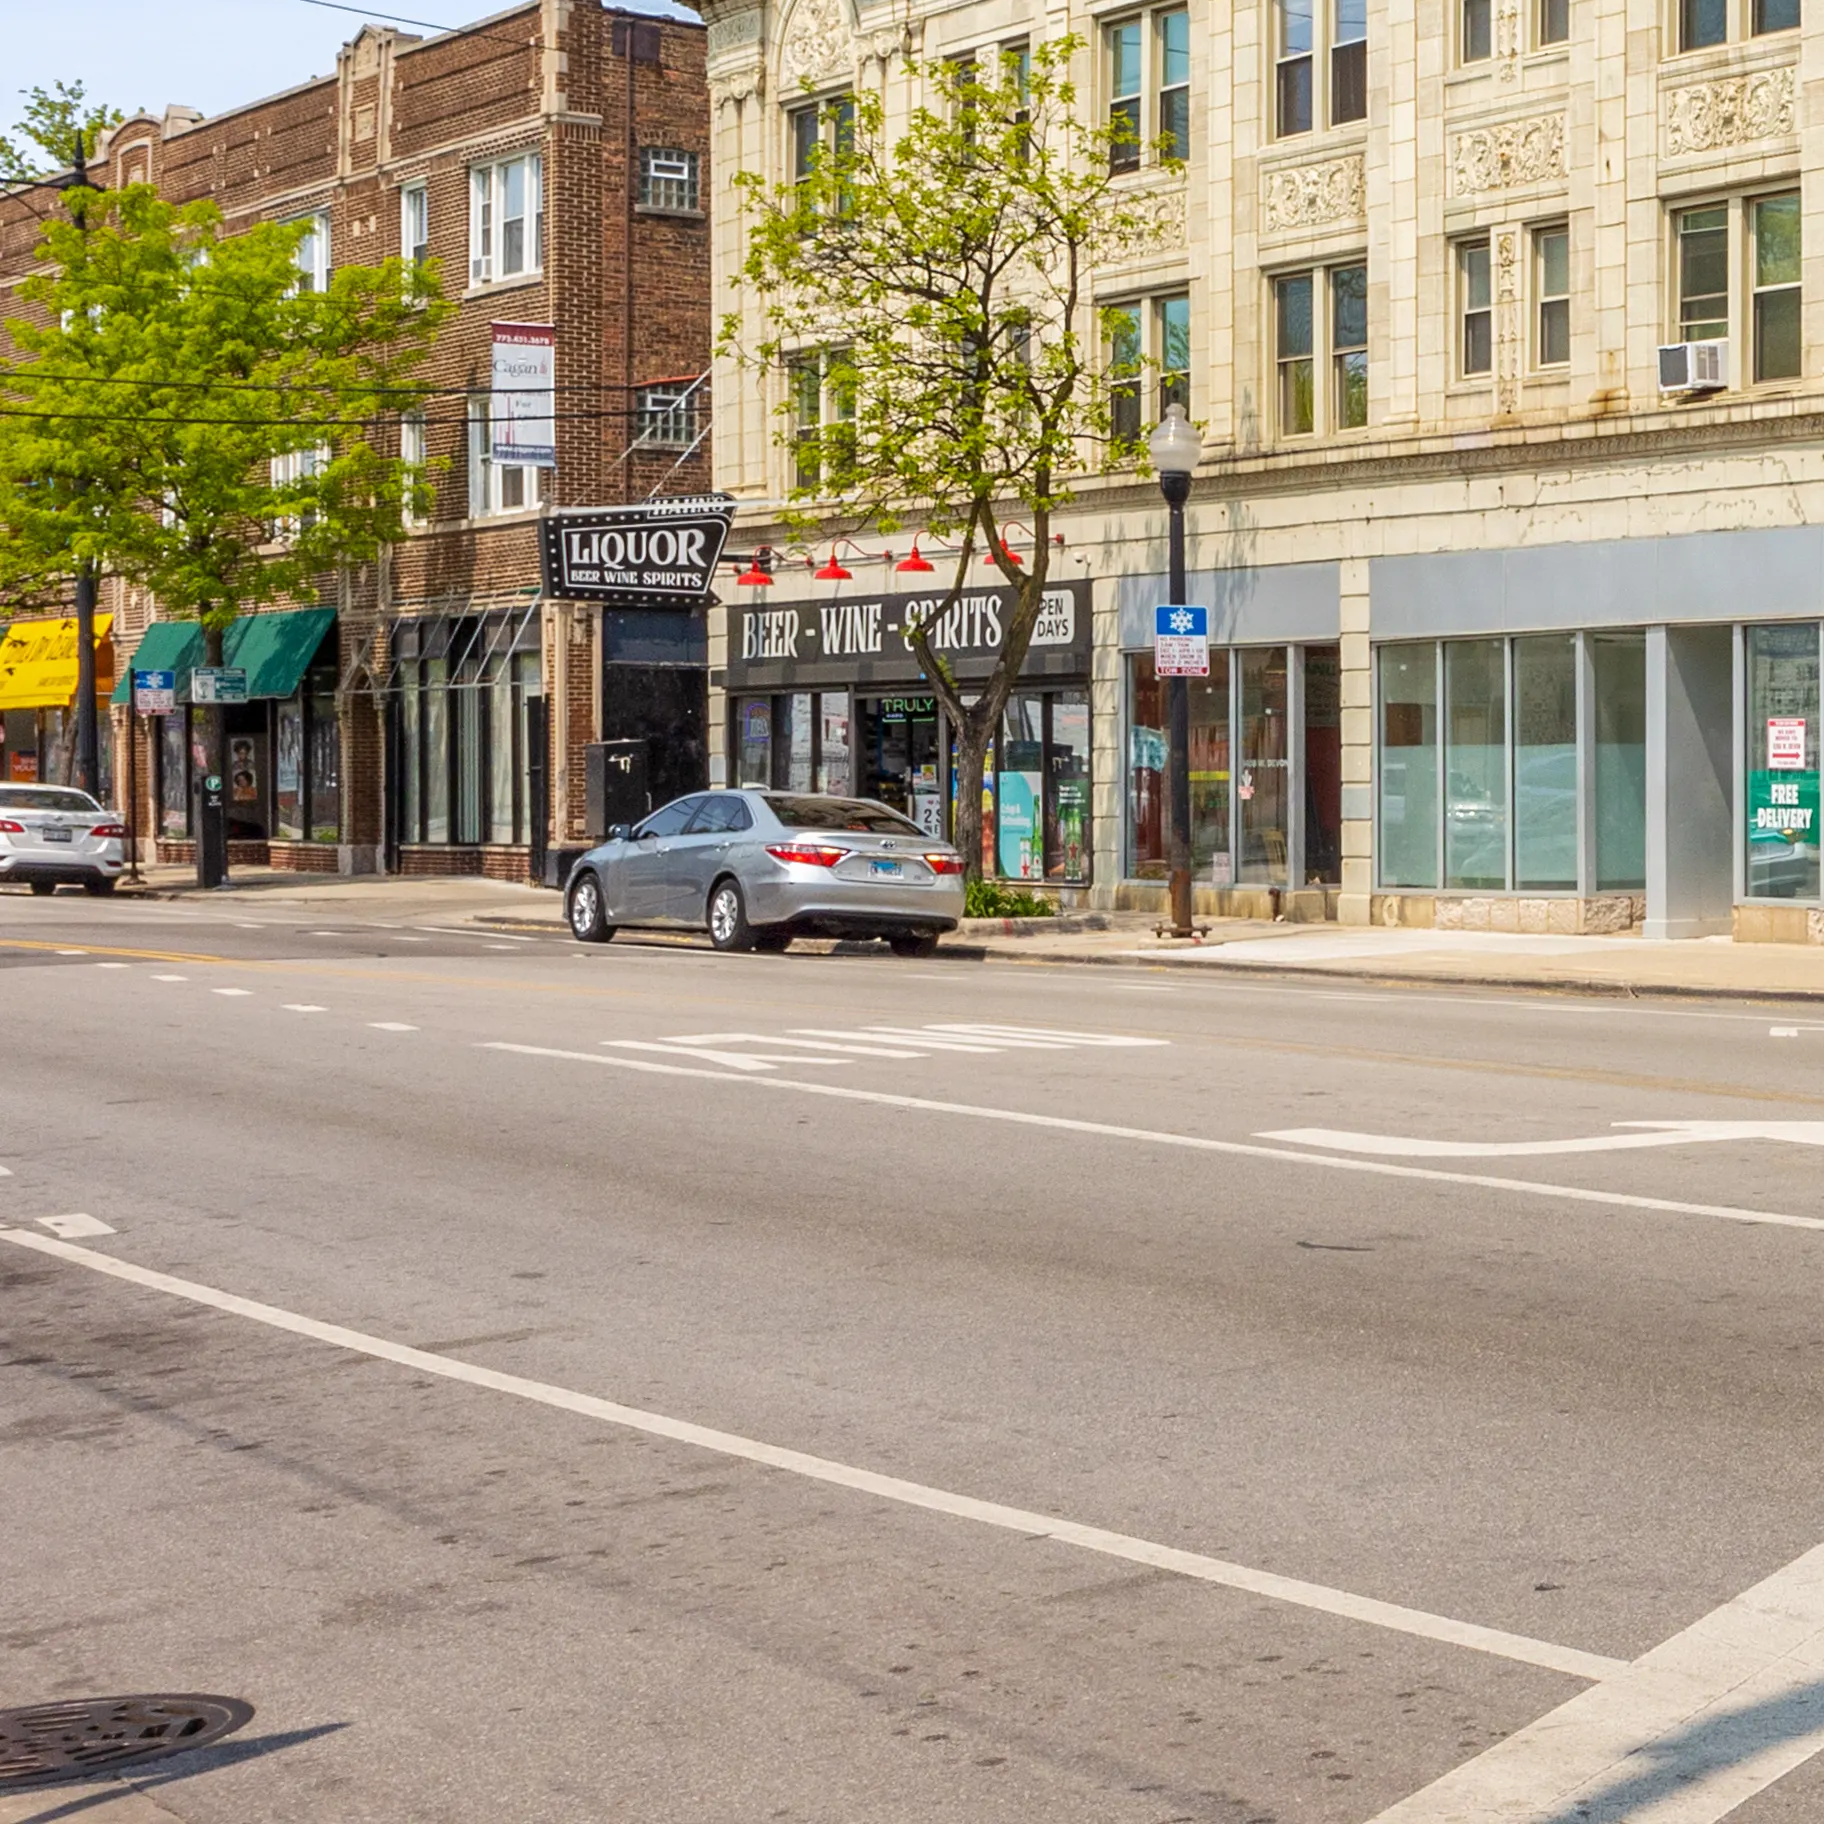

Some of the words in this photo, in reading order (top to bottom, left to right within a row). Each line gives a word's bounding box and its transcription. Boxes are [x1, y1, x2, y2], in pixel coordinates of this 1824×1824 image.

[570, 529, 707, 570] LIQUOR
[570, 570, 600, 582] BEER
[604, 571, 638, 584] WINE
[643, 573, 702, 587] SPIRITS
[1040, 598, 1063, 616] PEN
[742, 609, 799, 659] BEER
[820, 604, 882, 654] WINE
[882, 698, 934, 712] TRULY
[1771, 784, 1799, 805] FREE
[1757, 808, 1813, 829] DELIVERY
